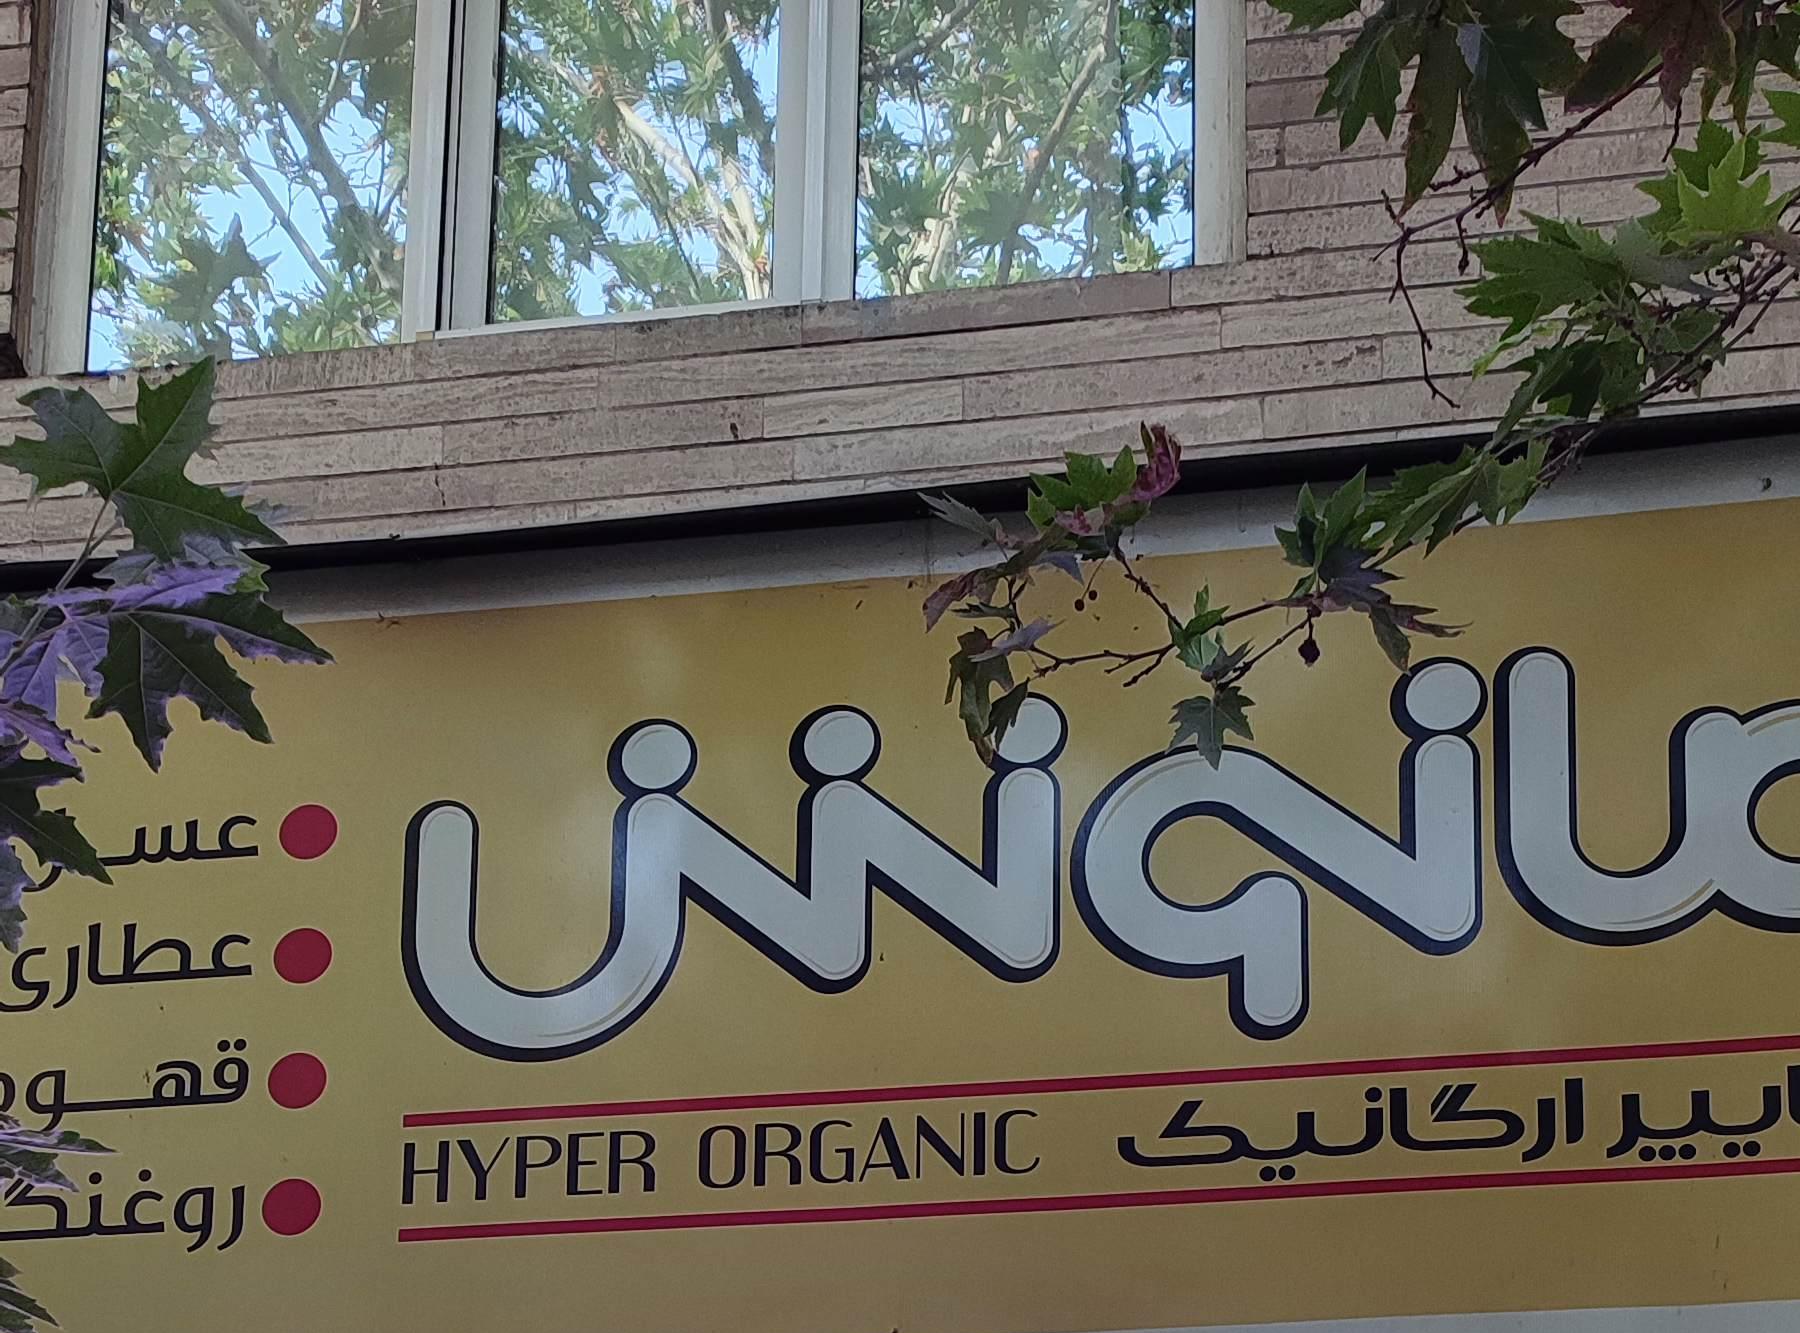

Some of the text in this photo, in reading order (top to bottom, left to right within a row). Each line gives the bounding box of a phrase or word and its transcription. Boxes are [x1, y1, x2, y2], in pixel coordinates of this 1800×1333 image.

[0, 921, 253, 1013] عطاری
[402, 1109, 1042, 1205] HYPER ORGANIC
[1116, 1064, 1800, 1182] ایپر ارگانیک
[0, 1168, 246, 1254] روغنگ
